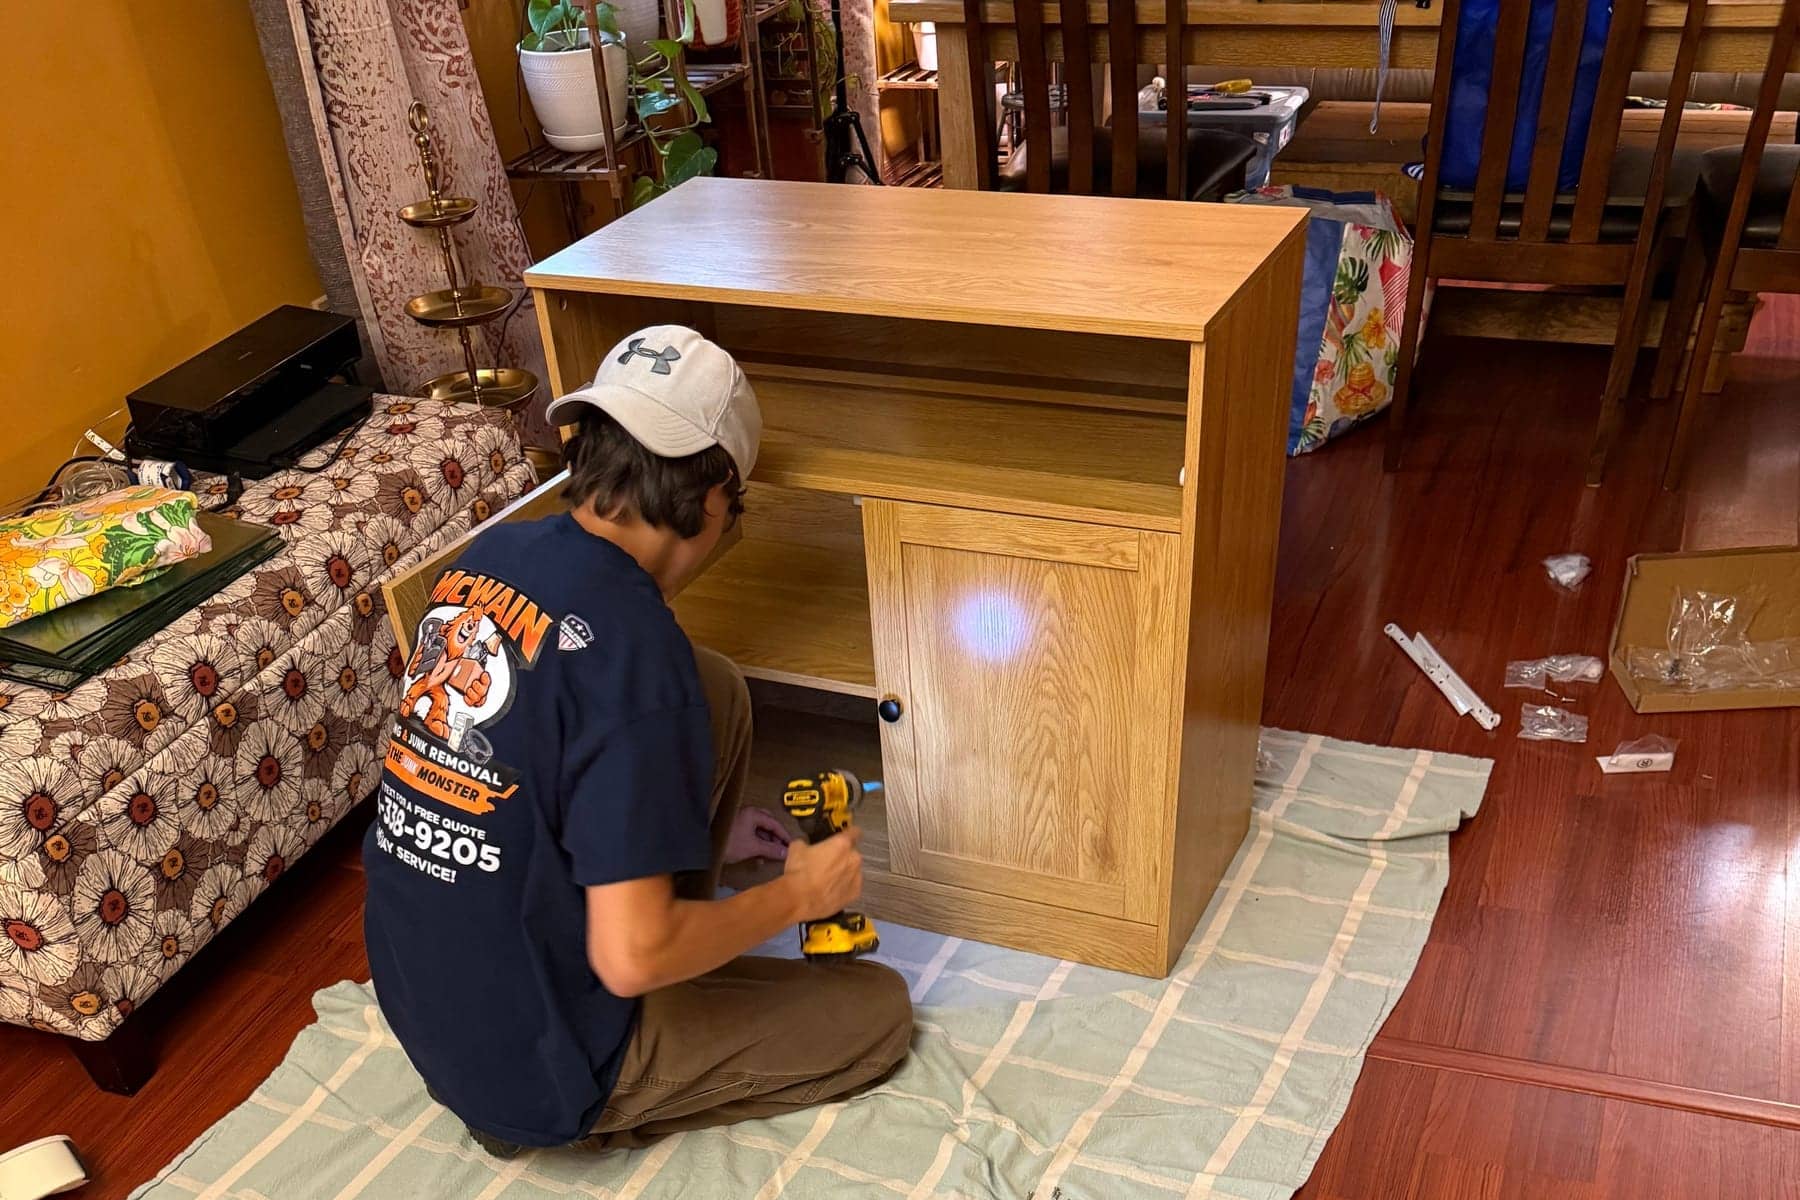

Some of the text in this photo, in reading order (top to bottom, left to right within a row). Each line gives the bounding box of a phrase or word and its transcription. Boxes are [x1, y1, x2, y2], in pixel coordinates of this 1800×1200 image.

[408, 733, 428, 754] JUNK
[429, 746, 503, 786] REMOVAL
[417, 767, 480, 802] MONSTER
[407, 801, 412, 813] A
[414, 805, 440, 825] FREE
[442, 818, 486, 840] QUOTE
[396, 846, 457, 883] SERVICE!
